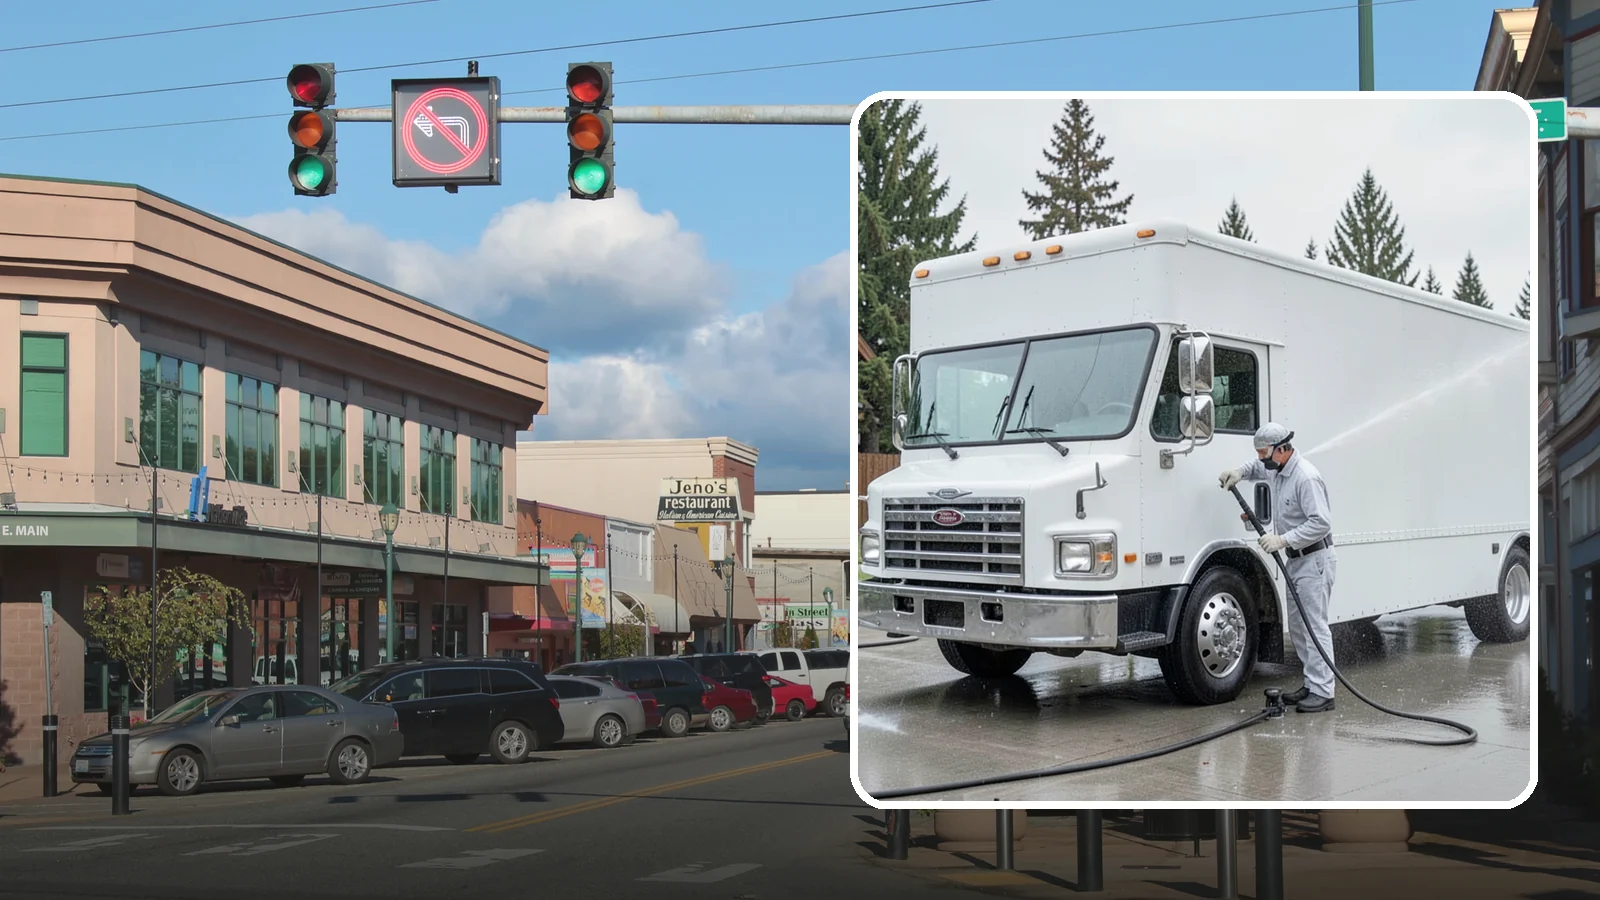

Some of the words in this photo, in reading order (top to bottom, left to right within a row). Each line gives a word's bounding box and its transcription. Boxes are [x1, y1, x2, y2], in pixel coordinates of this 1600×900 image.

[669, 480, 727, 494] Jeno's
[665, 496, 731, 509] restaurant
[686, 509, 714, 519] American
[715, 510, 737, 519] Cuisine
[2, 525, 13, 536] E.
[15, 525, 49, 536] MAIN
[797, 607, 828, 617] Street
[791, 619, 824, 627] lass
